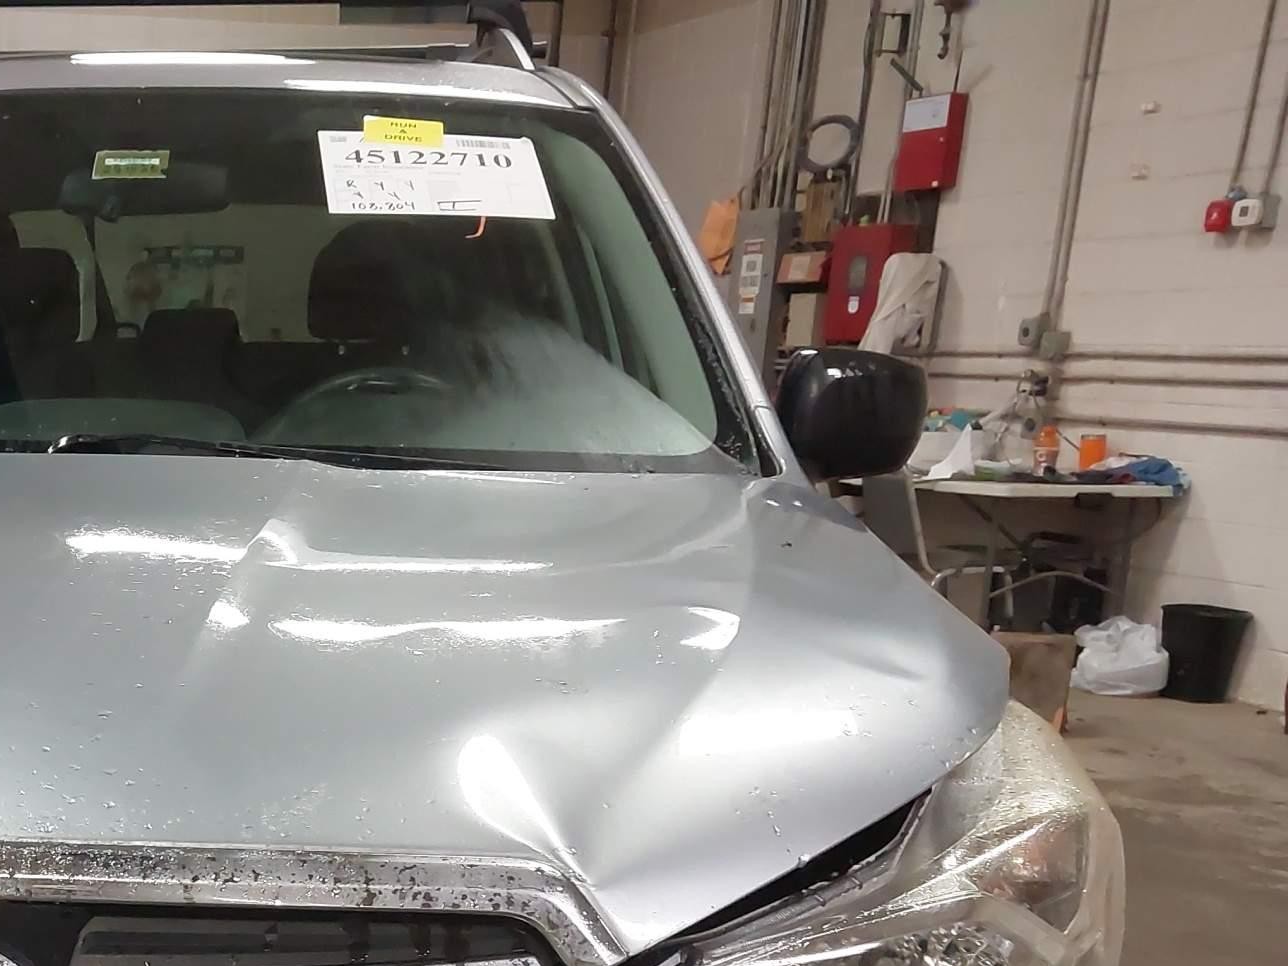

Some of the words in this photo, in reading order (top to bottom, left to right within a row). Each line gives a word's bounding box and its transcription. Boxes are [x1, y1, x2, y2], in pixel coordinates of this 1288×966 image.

[390, 121, 417, 129] RUN
[384, 134, 423, 143] DRIVE
[344, 149, 512, 169] 45122710
